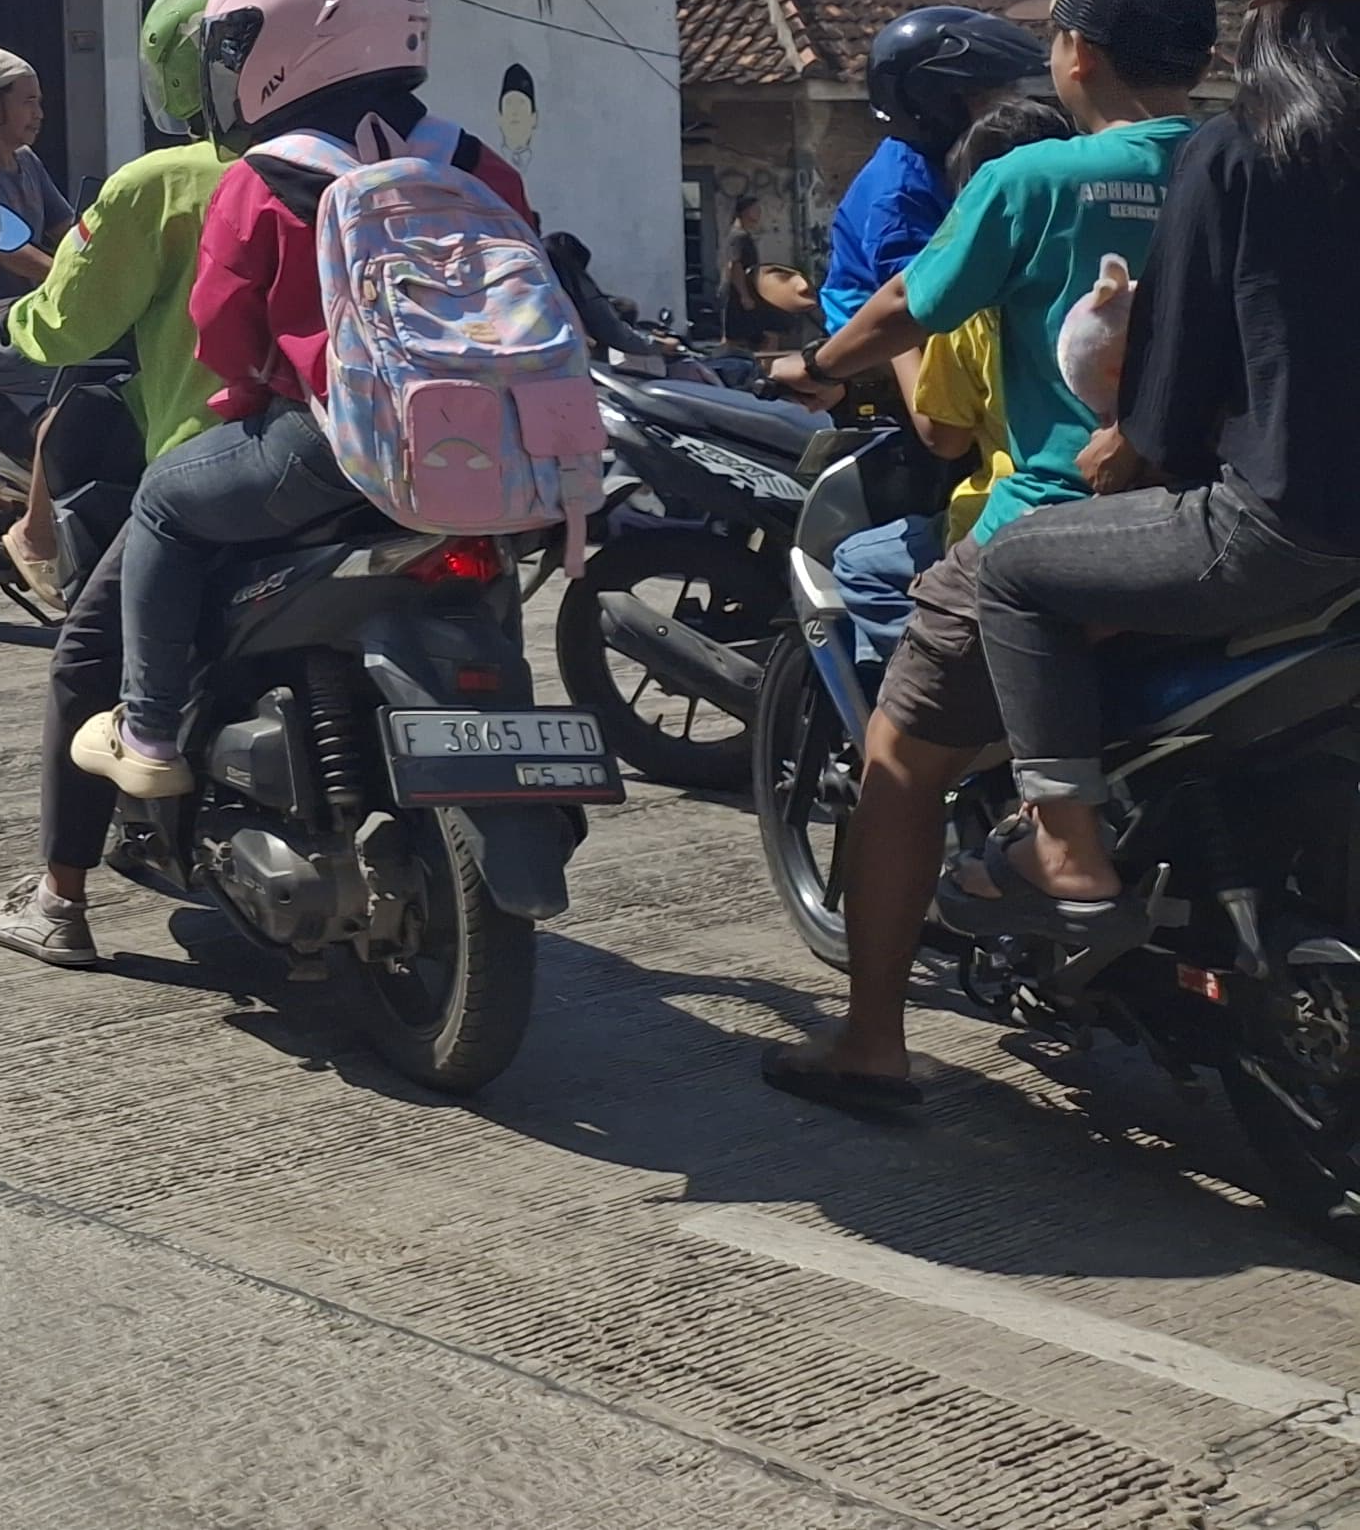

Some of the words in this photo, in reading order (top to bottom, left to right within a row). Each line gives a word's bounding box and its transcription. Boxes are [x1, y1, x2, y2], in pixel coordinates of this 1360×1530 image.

[261, 65, 285, 105] ALV
[404, 723, 417, 754] F
[441, 720, 523, 753] 3865
[538, 721, 598, 753] FFD
